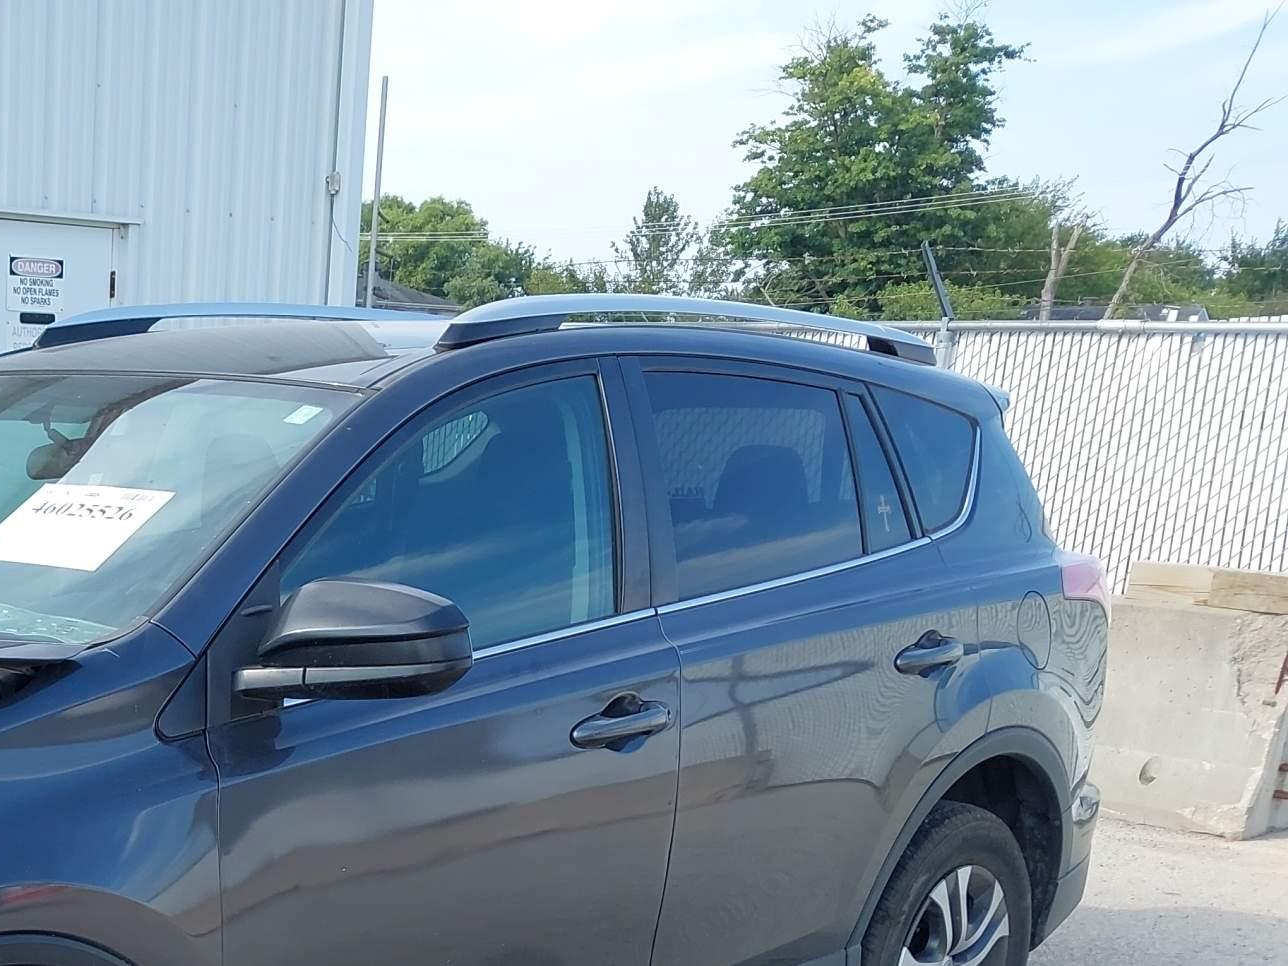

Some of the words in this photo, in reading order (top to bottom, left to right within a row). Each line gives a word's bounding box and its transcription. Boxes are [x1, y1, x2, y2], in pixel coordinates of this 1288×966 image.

[17, 261, 56, 274] DANGER
[19, 277, 27, 286] NO
[29, 278, 53, 287] SMOKING
[13, 287, 21, 295] NO
[22, 287, 37, 296] OPEN
[38, 288, 59, 297] FLAMES
[21, 296, 29, 305] NO
[30, 297, 51, 306] SPARKS
[32, 501, 134, 520] 46025526
